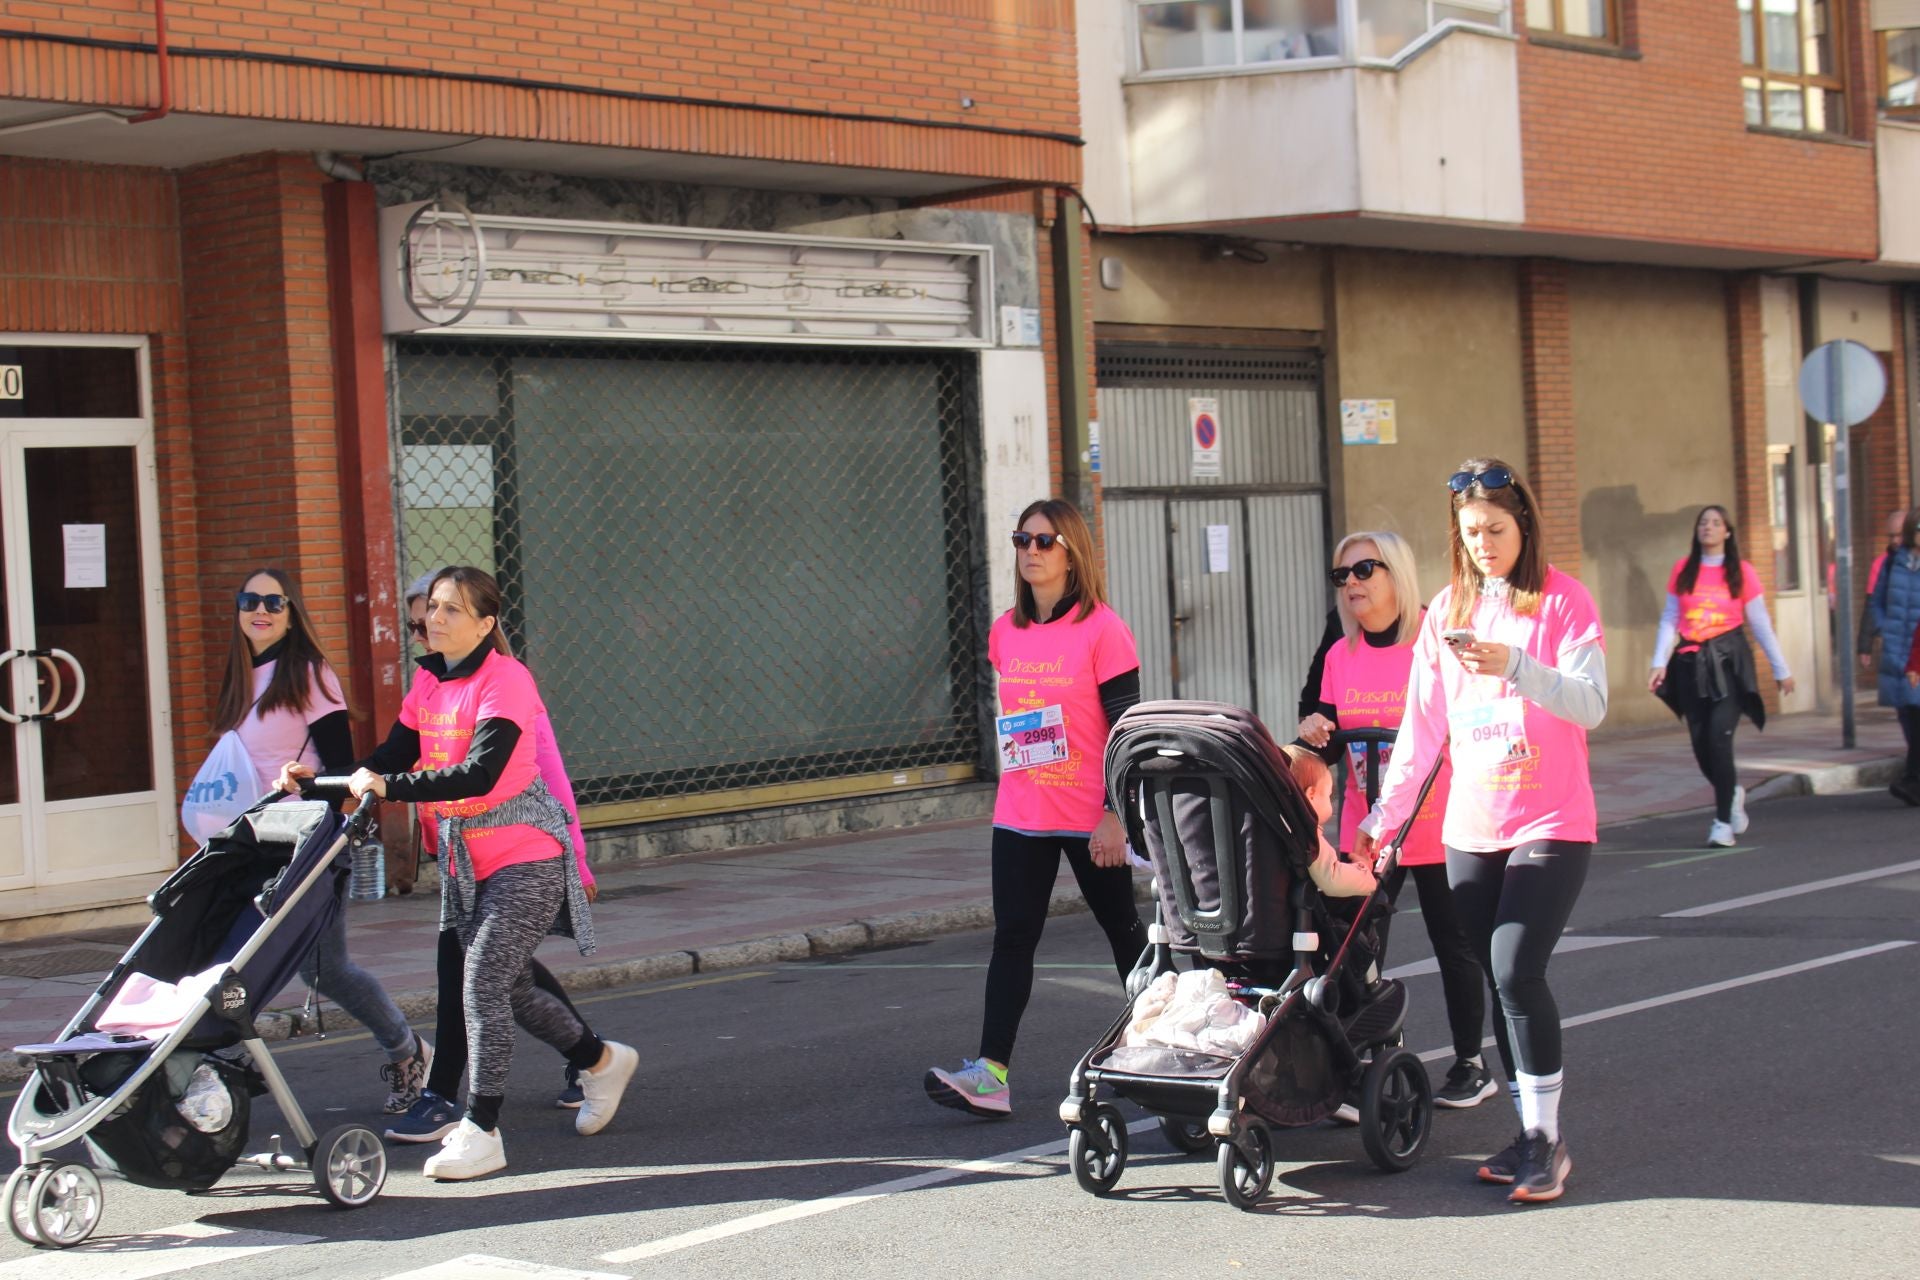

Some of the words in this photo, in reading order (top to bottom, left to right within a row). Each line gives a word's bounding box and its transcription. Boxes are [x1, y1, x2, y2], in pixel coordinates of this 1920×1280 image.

[1007, 655, 1064, 673] Drasanvi
[1024, 727, 1056, 744] 2998
[1472, 722, 1509, 742] 0947
[1034, 779, 1084, 787] DRASANVI
[464, 830, 494, 839] SANVI
[223, 990, 240, 999] baby
[223, 999, 245, 1009] jogger
